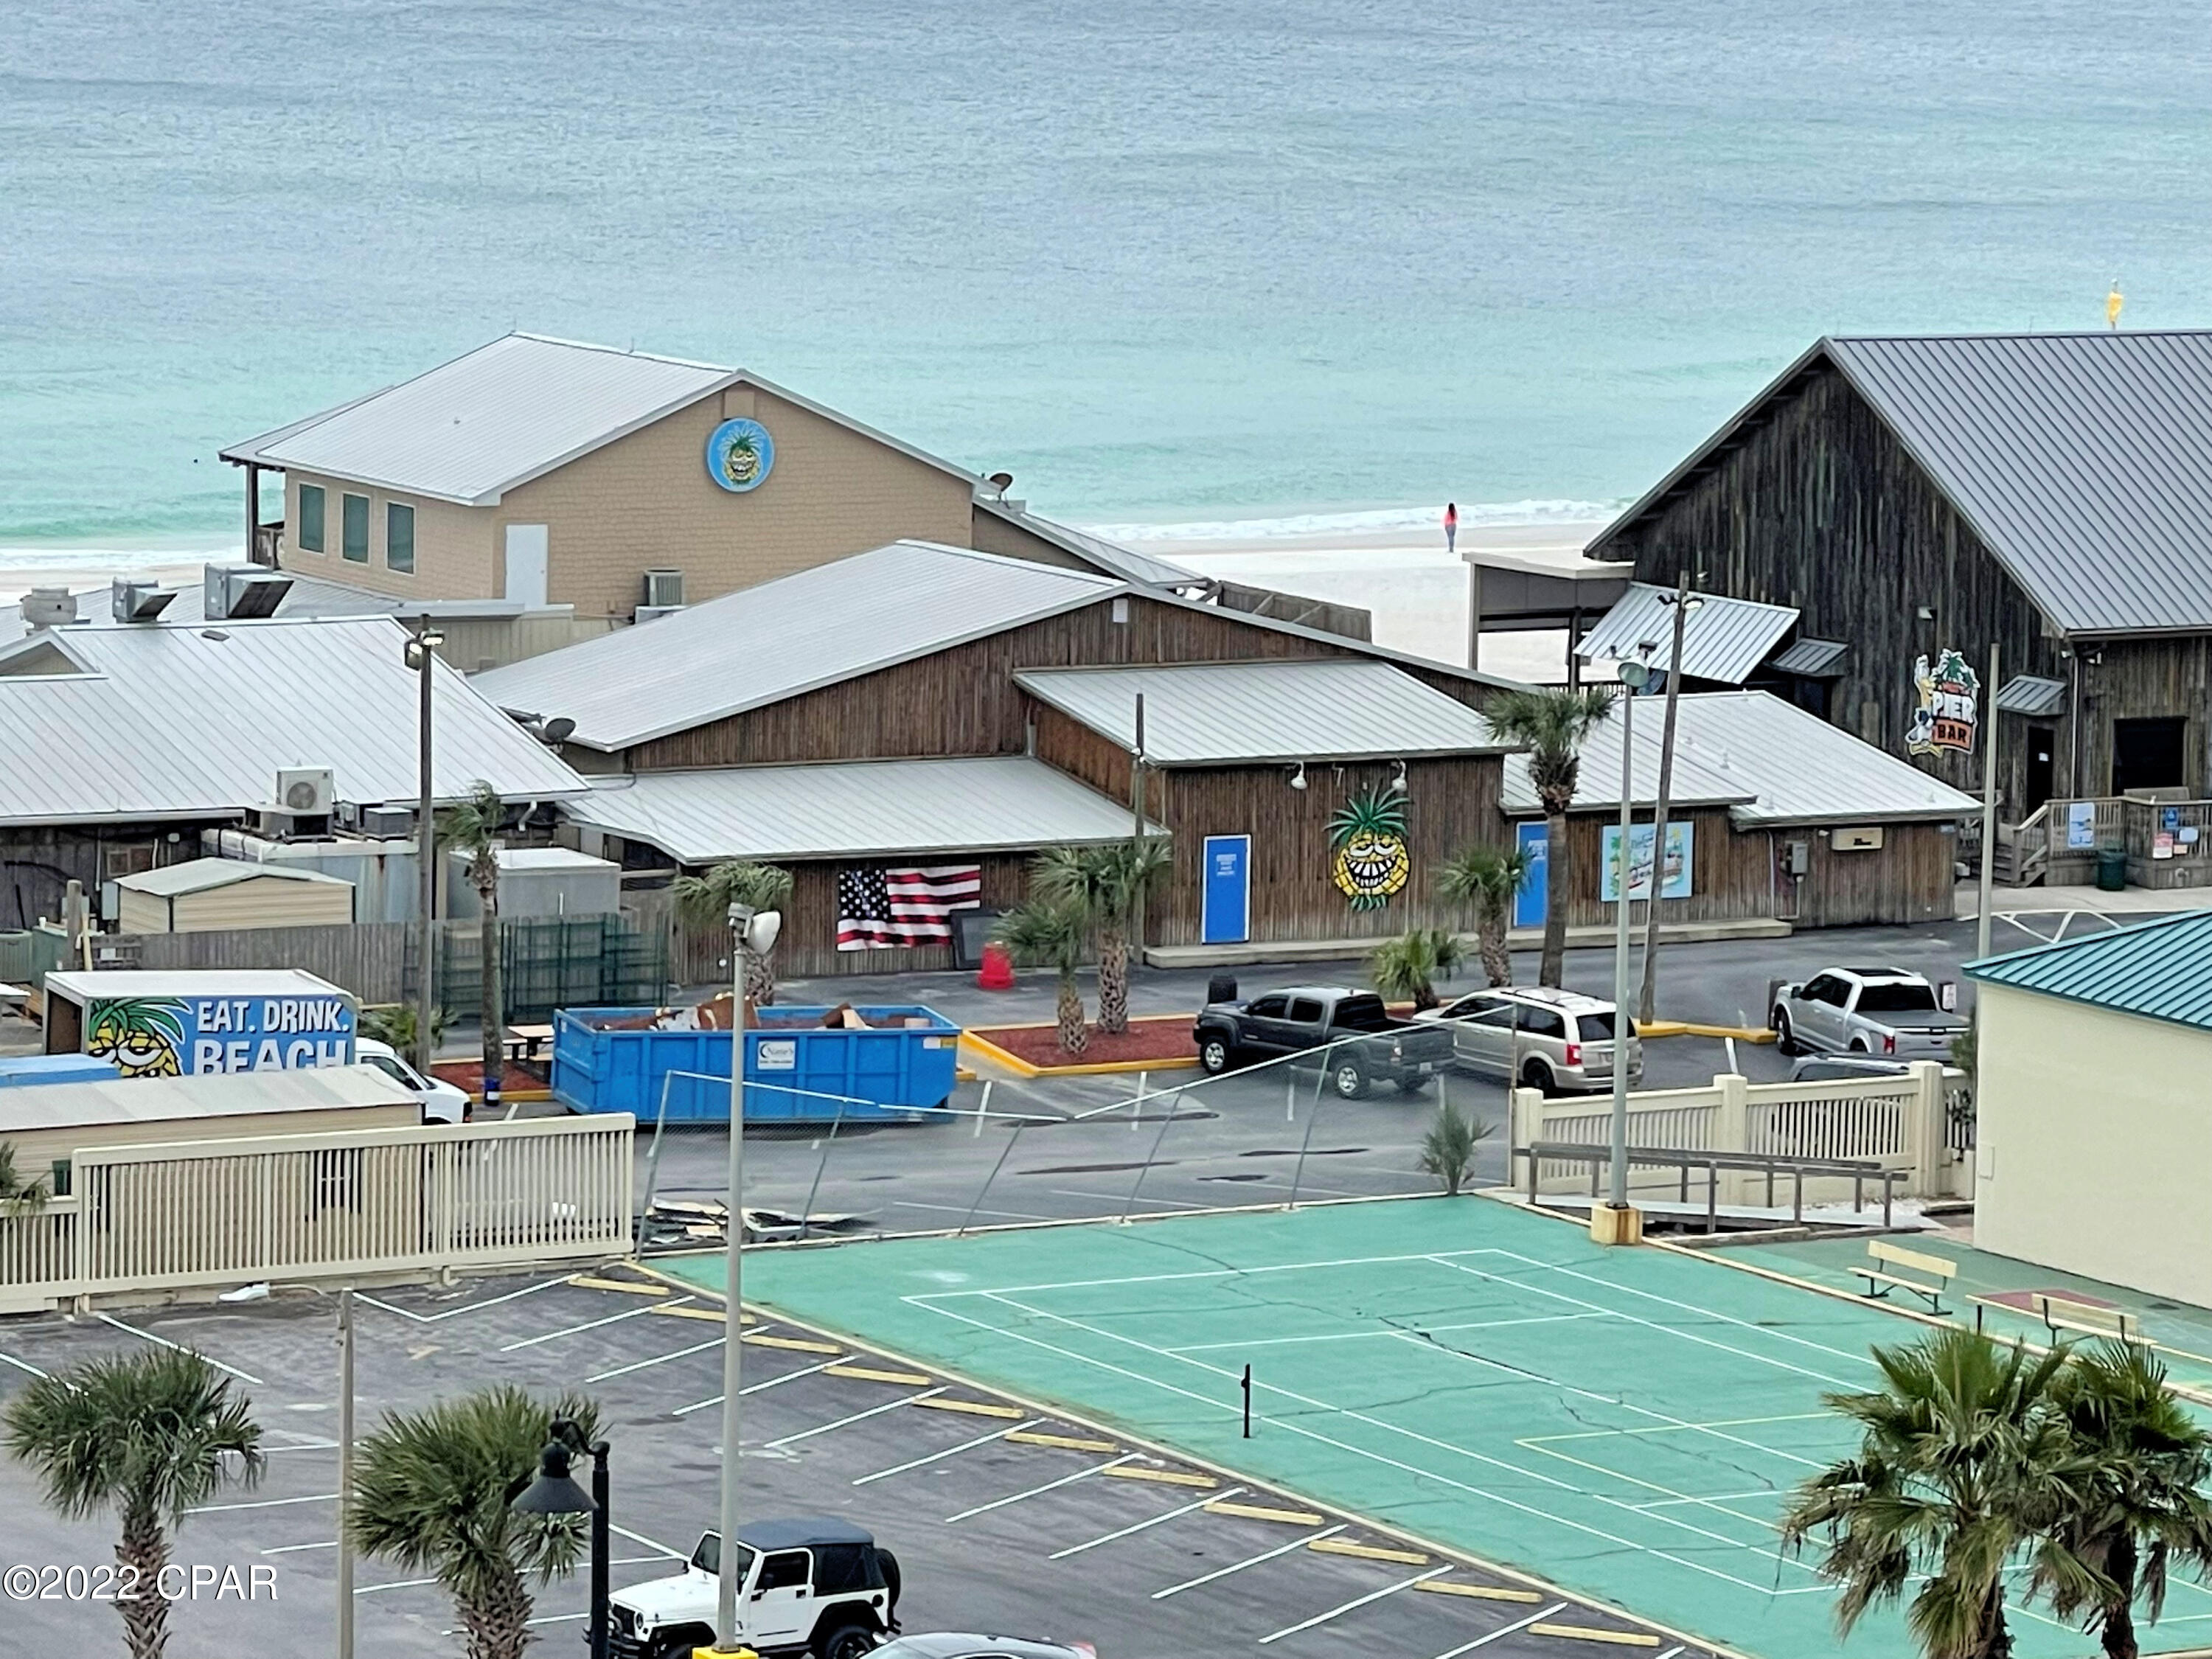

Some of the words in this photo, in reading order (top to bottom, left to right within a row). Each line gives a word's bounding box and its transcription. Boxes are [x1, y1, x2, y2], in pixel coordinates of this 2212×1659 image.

[1933, 691, 1975, 723] PIER
[1938, 725, 1966, 743] BAR
[197, 1000, 256, 1032] EAT.
[263, 999, 349, 1034] DRINK.
[194, 1039, 347, 1075] BEACH
